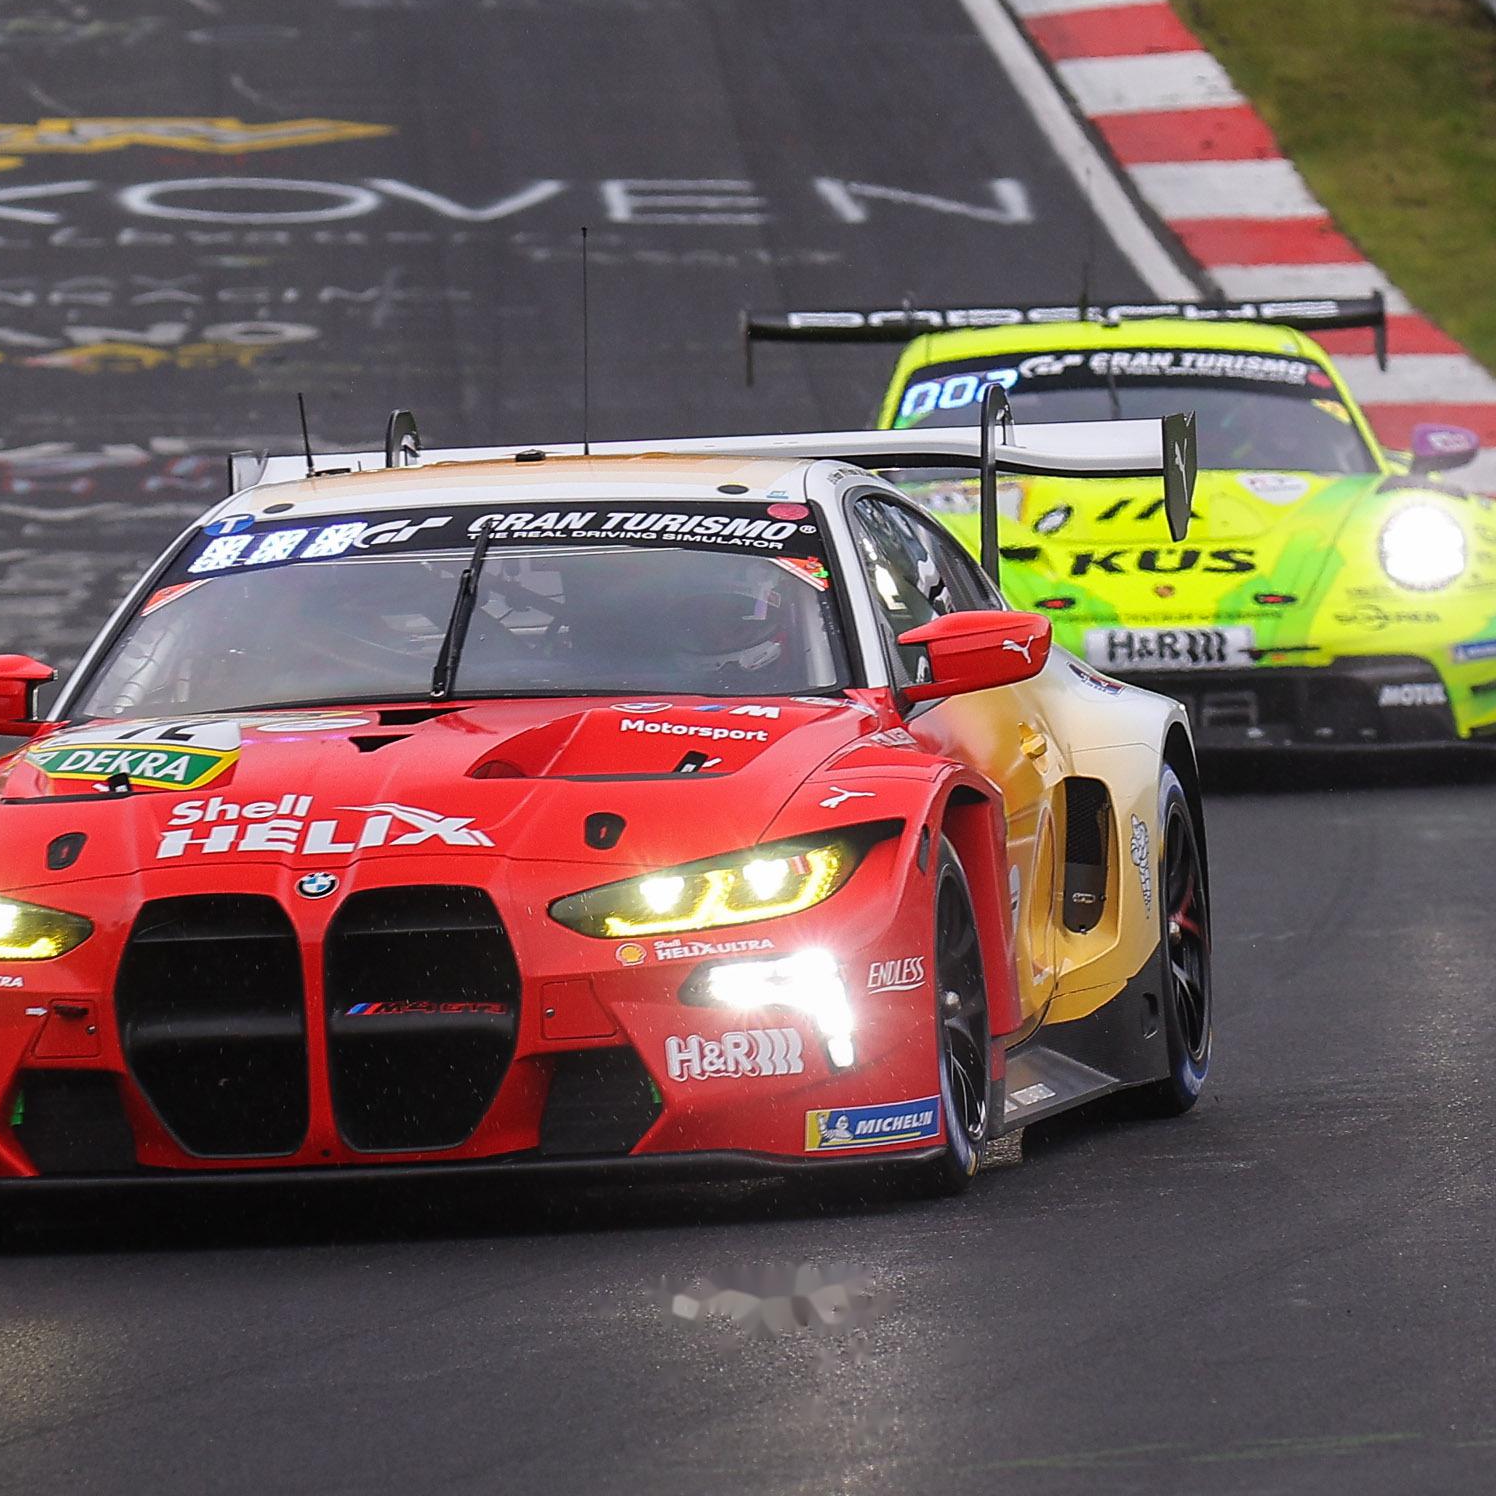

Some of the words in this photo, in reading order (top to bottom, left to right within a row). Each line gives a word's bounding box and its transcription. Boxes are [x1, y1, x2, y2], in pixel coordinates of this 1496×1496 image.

[467, 510, 598, 533] GRAN
[512, 529, 567, 540] REAL
[570, 529, 658, 542] DRIVING
[661, 532, 784, 550] SIMULATOR
[1069, 548, 1257, 576] KÜS
[1106, 629, 1183, 663] H&R
[619, 718, 769, 742] Motorsport
[55, 749, 192, 782] DEKRA
[167, 793, 315, 826] Shell
[156, 802, 497, 859] HELIX
[655, 940, 715, 961] HELIX
[713, 938, 775, 955] ULTRA
[866, 955, 926, 989] ENDLESS
[664, 1031, 762, 1082] H&R
[854, 1109, 935, 1135] MICHELIN
